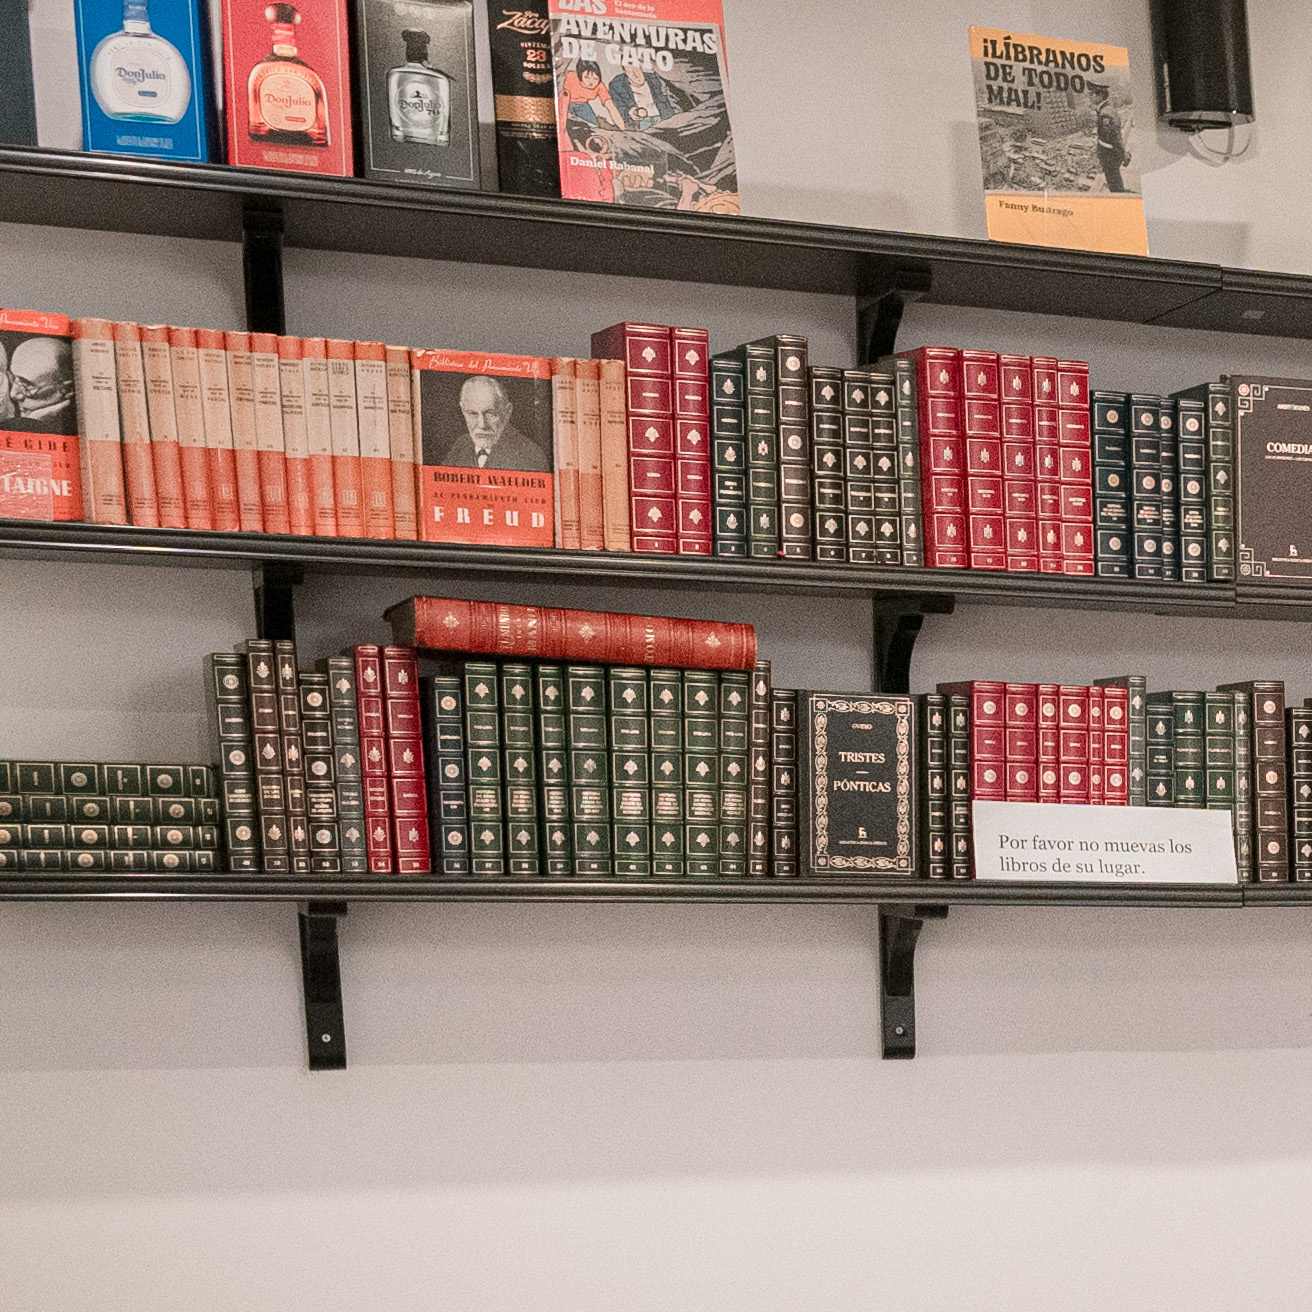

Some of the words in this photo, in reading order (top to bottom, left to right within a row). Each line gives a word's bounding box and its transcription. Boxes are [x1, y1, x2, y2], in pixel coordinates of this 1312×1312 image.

[560, 15, 718, 54] AVENTURAS
[561, 36, 597, 61] DE
[983, 35, 1105, 74] ¡LÍBRANOS
[984, 61, 1015, 82] DE
[1023, 67, 1086, 94] TODO
[986, 85, 1042, 111] MAL!
[570, 156, 607, 171] Daniel
[433, 472, 482, 486] ROBERT
[432, 506, 547, 529] FREUD
[838, 751, 886, 764] TRISTES
[833, 780, 892, 793] PÓNTICAS
[999, 834, 1028, 850] Por
[1033, 834, 1075, 852] favor
[1079, 841, 1100, 852] no
[1104, 841, 1166, 854] muevas
[1169, 839, 1193, 855] los
[999, 856, 1048, 874] libros
[1052, 858, 1072, 874] de
[1076, 863, 1094, 874] su
[1099, 859, 1146, 877] lugar.
